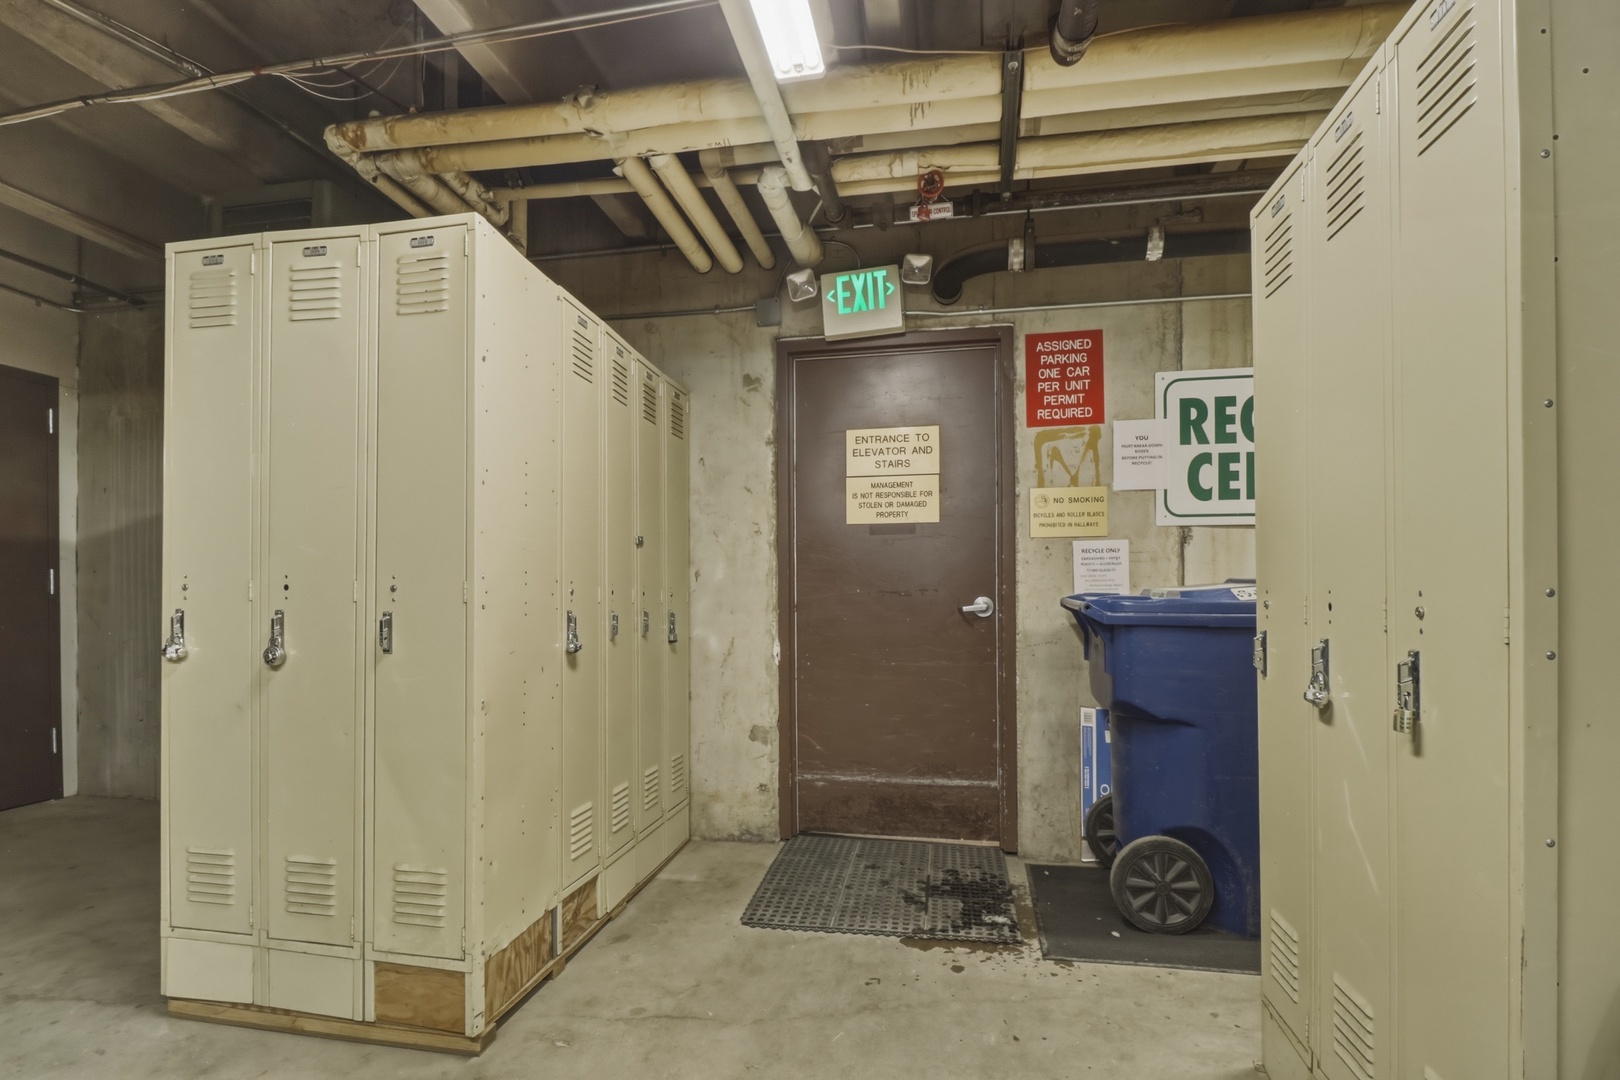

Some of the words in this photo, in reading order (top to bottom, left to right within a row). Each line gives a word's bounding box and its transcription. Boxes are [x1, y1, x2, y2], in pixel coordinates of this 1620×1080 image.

[836, 270, 887, 315] EXIT
[1036, 339, 1091, 352] ASSIGNED
[1041, 353, 1087, 365] PARKING
[1038, 368, 1061, 378] ONE
[1067, 366, 1090, 377] CAR
[1038, 382, 1059, 392] PER
[1065, 380, 1090, 391] UNIT
[1044, 394, 1085, 405] PERMIT
[1038, 407, 1092, 420] REQUIRED
[855, 434, 909, 444] ENTRANCE
[915, 433, 929, 441] TO
[853, 447, 906, 457] ELEVATOR
[912, 446, 932, 454] AND
[875, 459, 910, 468] STAIRS
[1187, 452, 1255, 501] CE
